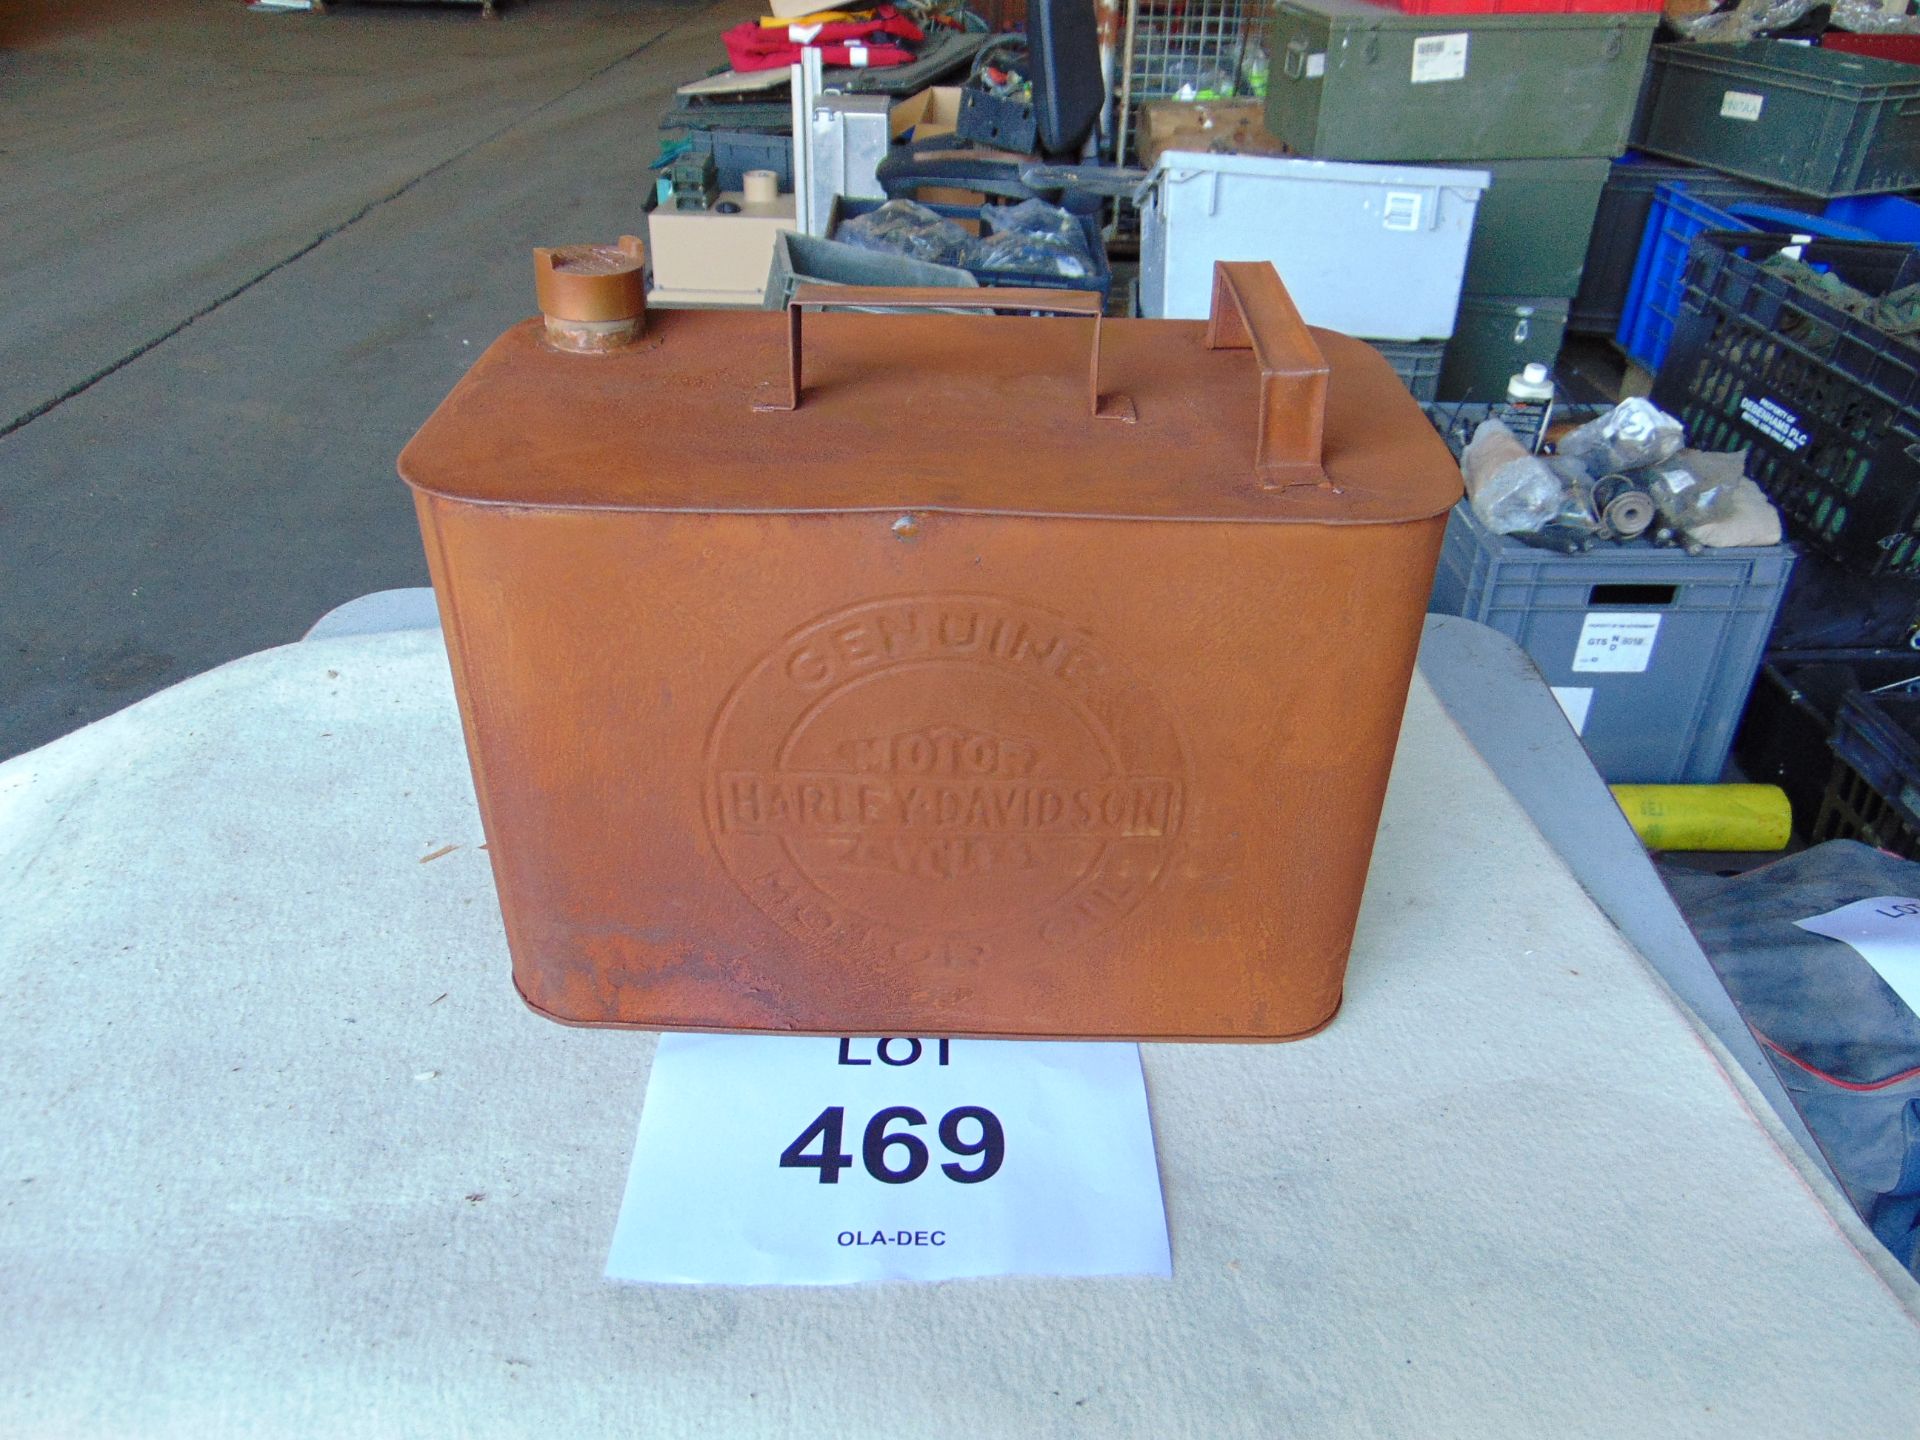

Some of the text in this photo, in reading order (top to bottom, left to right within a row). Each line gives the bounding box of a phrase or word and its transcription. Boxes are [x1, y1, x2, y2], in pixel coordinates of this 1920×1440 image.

[1740, 397, 1808, 446] DEBENHAMS PLC
[785, 609, 1103, 690] GENUINE
[1587, 638, 1608, 646] GTS
[848, 724, 1040, 775] MOTOR
[779, 1106, 1005, 1184] 469
[837, 1230, 946, 1246] OLA-DEC
